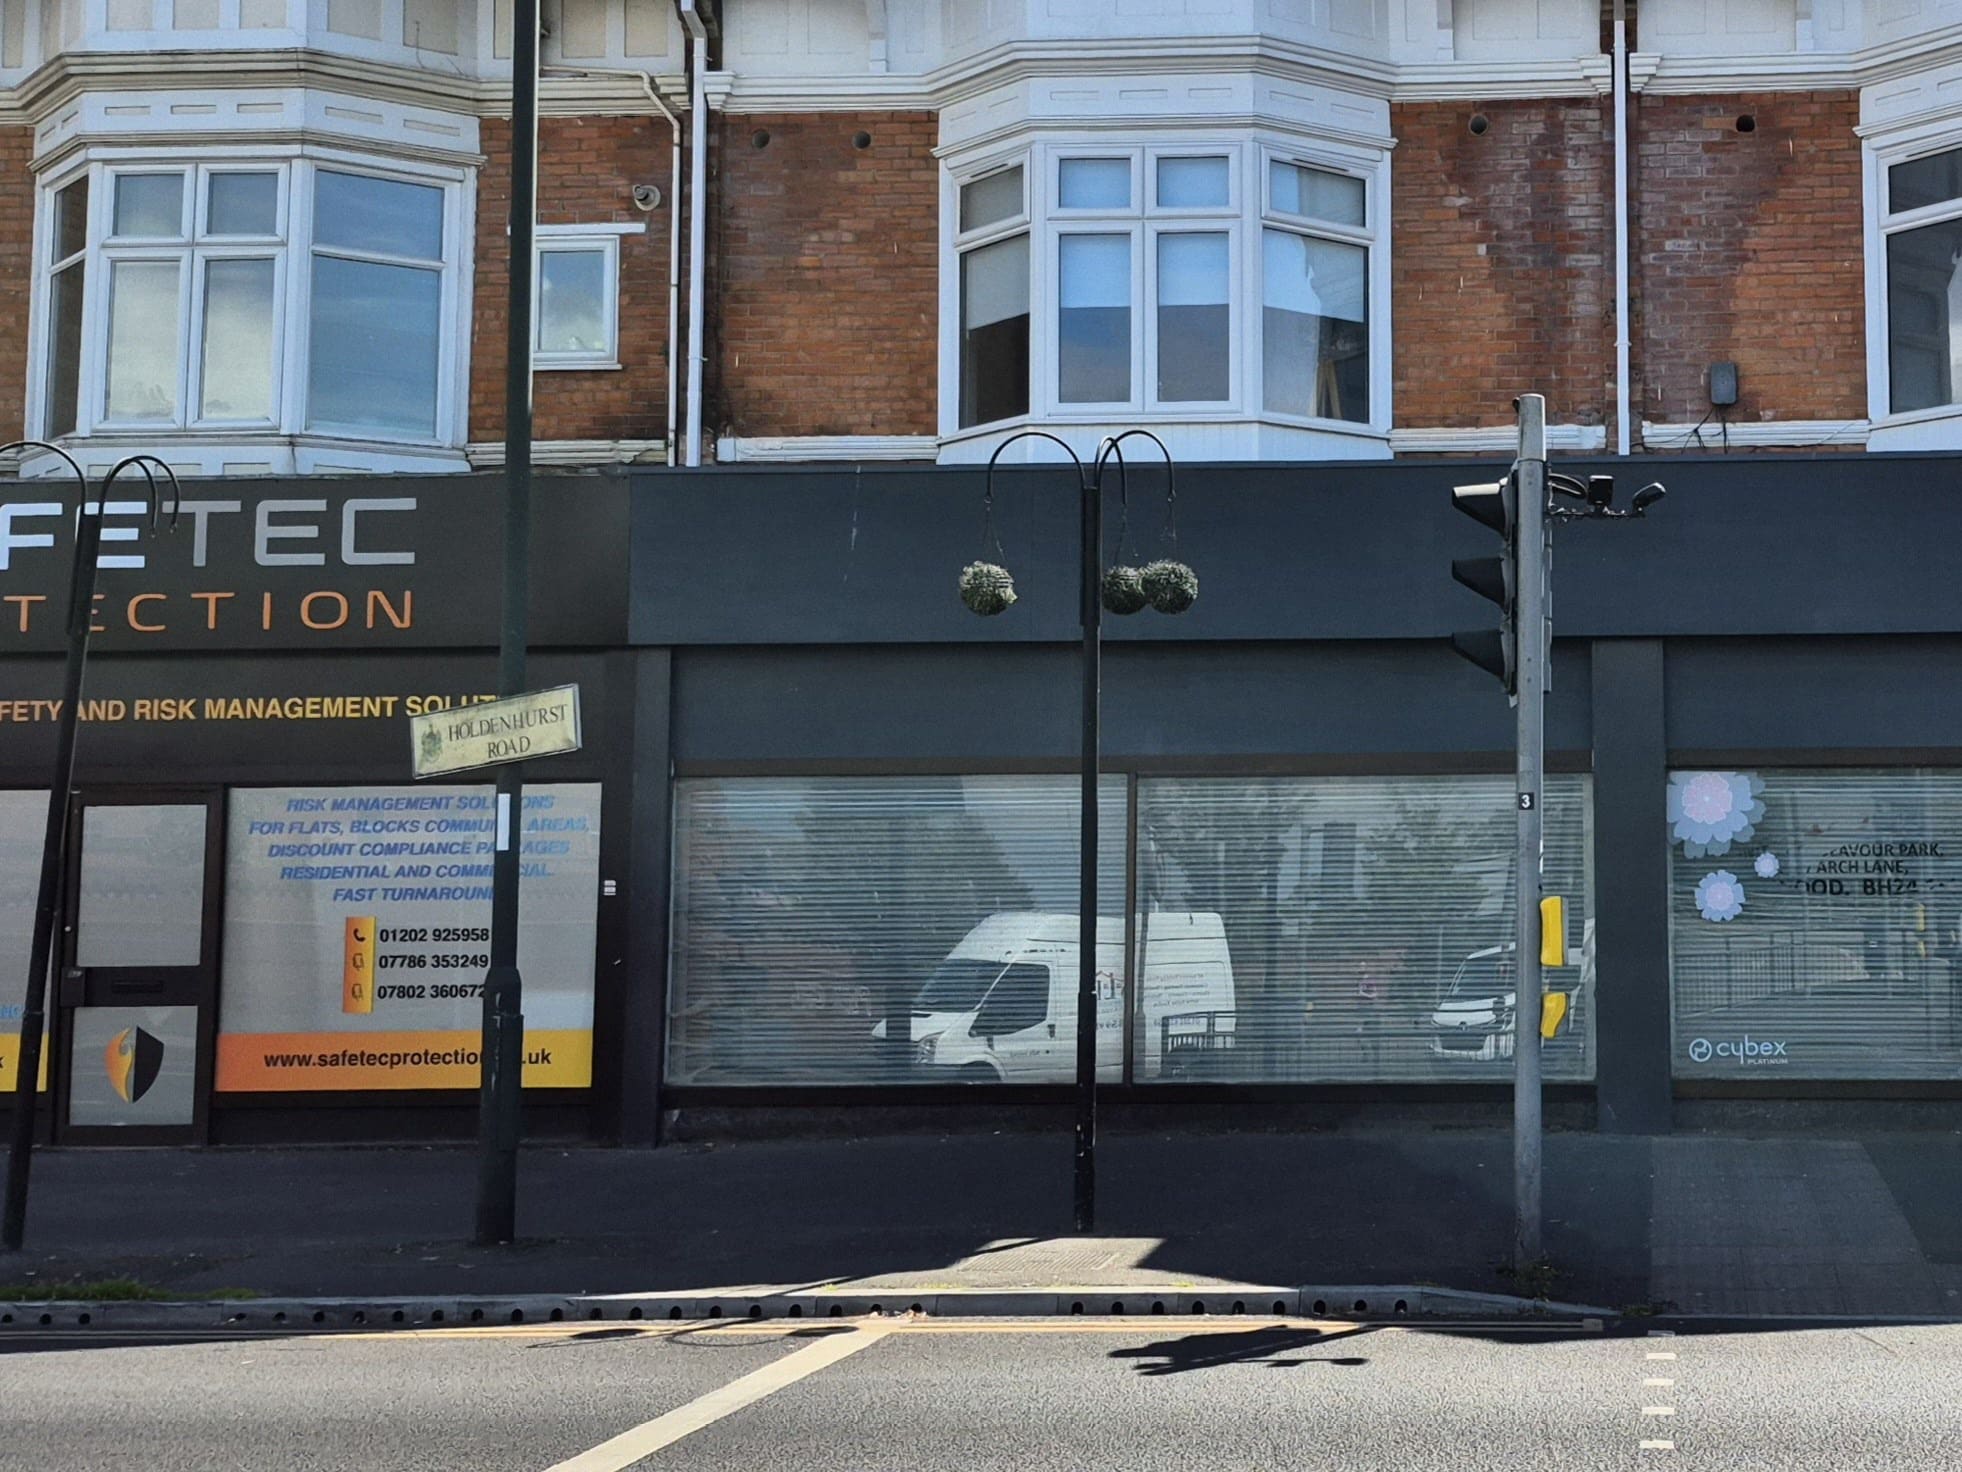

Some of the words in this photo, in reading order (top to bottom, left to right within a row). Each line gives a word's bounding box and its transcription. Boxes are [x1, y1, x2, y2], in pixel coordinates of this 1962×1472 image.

[0, 498, 417, 570] FETEC
[76, 698, 126, 721] AND
[133, 698, 197, 721] RISK
[204, 695, 398, 719] MANAGEMENT
[448, 703, 569, 743] HOLDENHURST
[487, 736, 532, 759] ROAD
[286, 797, 328, 812] RISK
[331, 796, 455, 812] MANAGEMENT
[456, 795, 556, 811] SOLONS
[1521, 794, 1531, 809] 3
[248, 820, 285, 836] FOR
[288, 820, 346, 837] FLATS,
[349, 819, 421, 834] BLOCKS
[267, 843, 356, 858] DISCOUNT
[359, 841, 472, 857] COMPLIANCE
[475, 840, 571, 856] PAAGES
[279, 865, 391, 880] RESIDENTIAL
[394, 864, 431, 878] AND
[1815, 859, 1859, 874] ARCH
[1863, 859, 1909, 876] LANE,
[332, 887, 378, 902] FAST
[379, 928, 428, 943] 01202
[432, 928, 490, 942] 925958
[378, 954, 427, 969] 07786
[430, 954, 489, 968] 353249
[377, 985, 426, 999] 07802
[429, 984, 486, 999] 360672
[1716, 1034, 1787, 1064] cybex
[263, 1048, 552, 1070] www.safetecprotectio.uk
